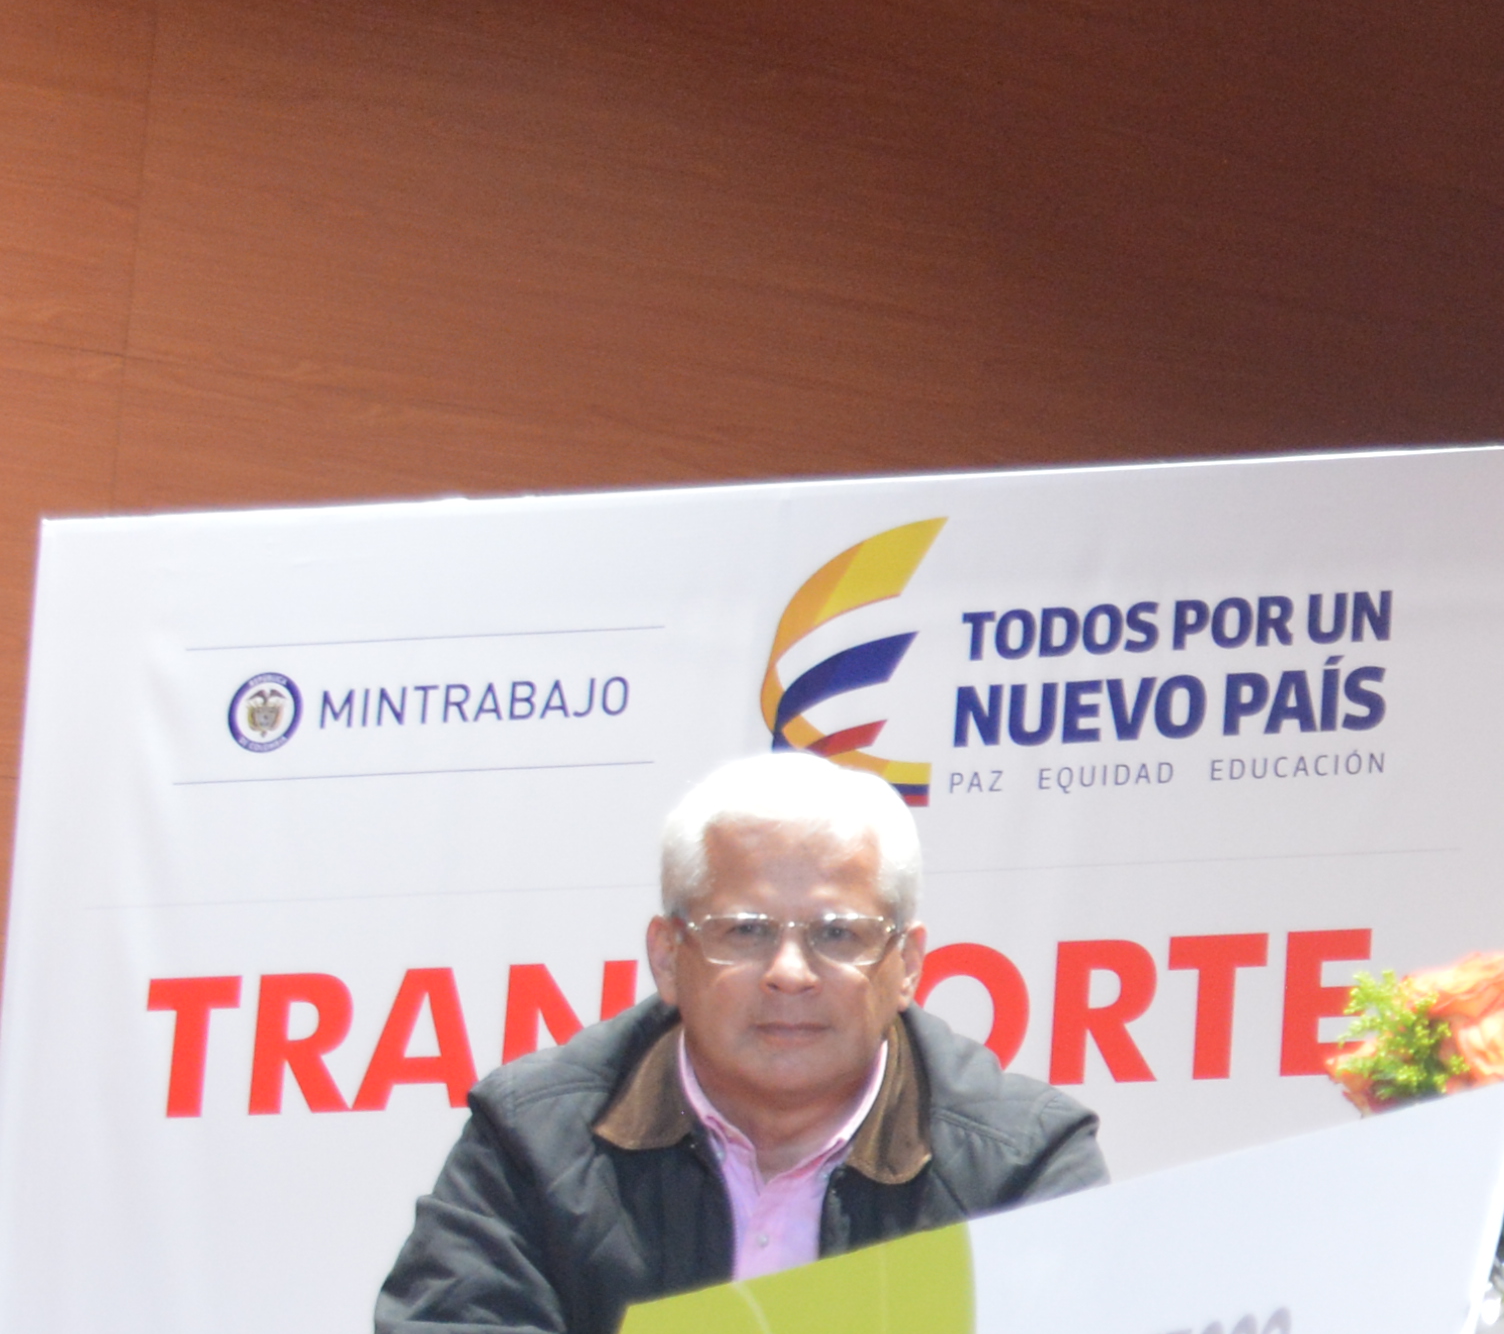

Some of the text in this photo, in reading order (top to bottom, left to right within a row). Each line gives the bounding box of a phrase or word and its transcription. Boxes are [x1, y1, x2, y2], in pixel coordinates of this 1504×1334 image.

[962, 589, 1393, 661] TODOS POR UN
[319, 676, 631, 730] MINTRABAJO
[953, 655, 1387, 748] NUEVO PAÍS
[949, 750, 1386, 794] PAZ EQUIDAD EDUCACIÓN
[146, 928, 1373, 1119] TRANORTE
